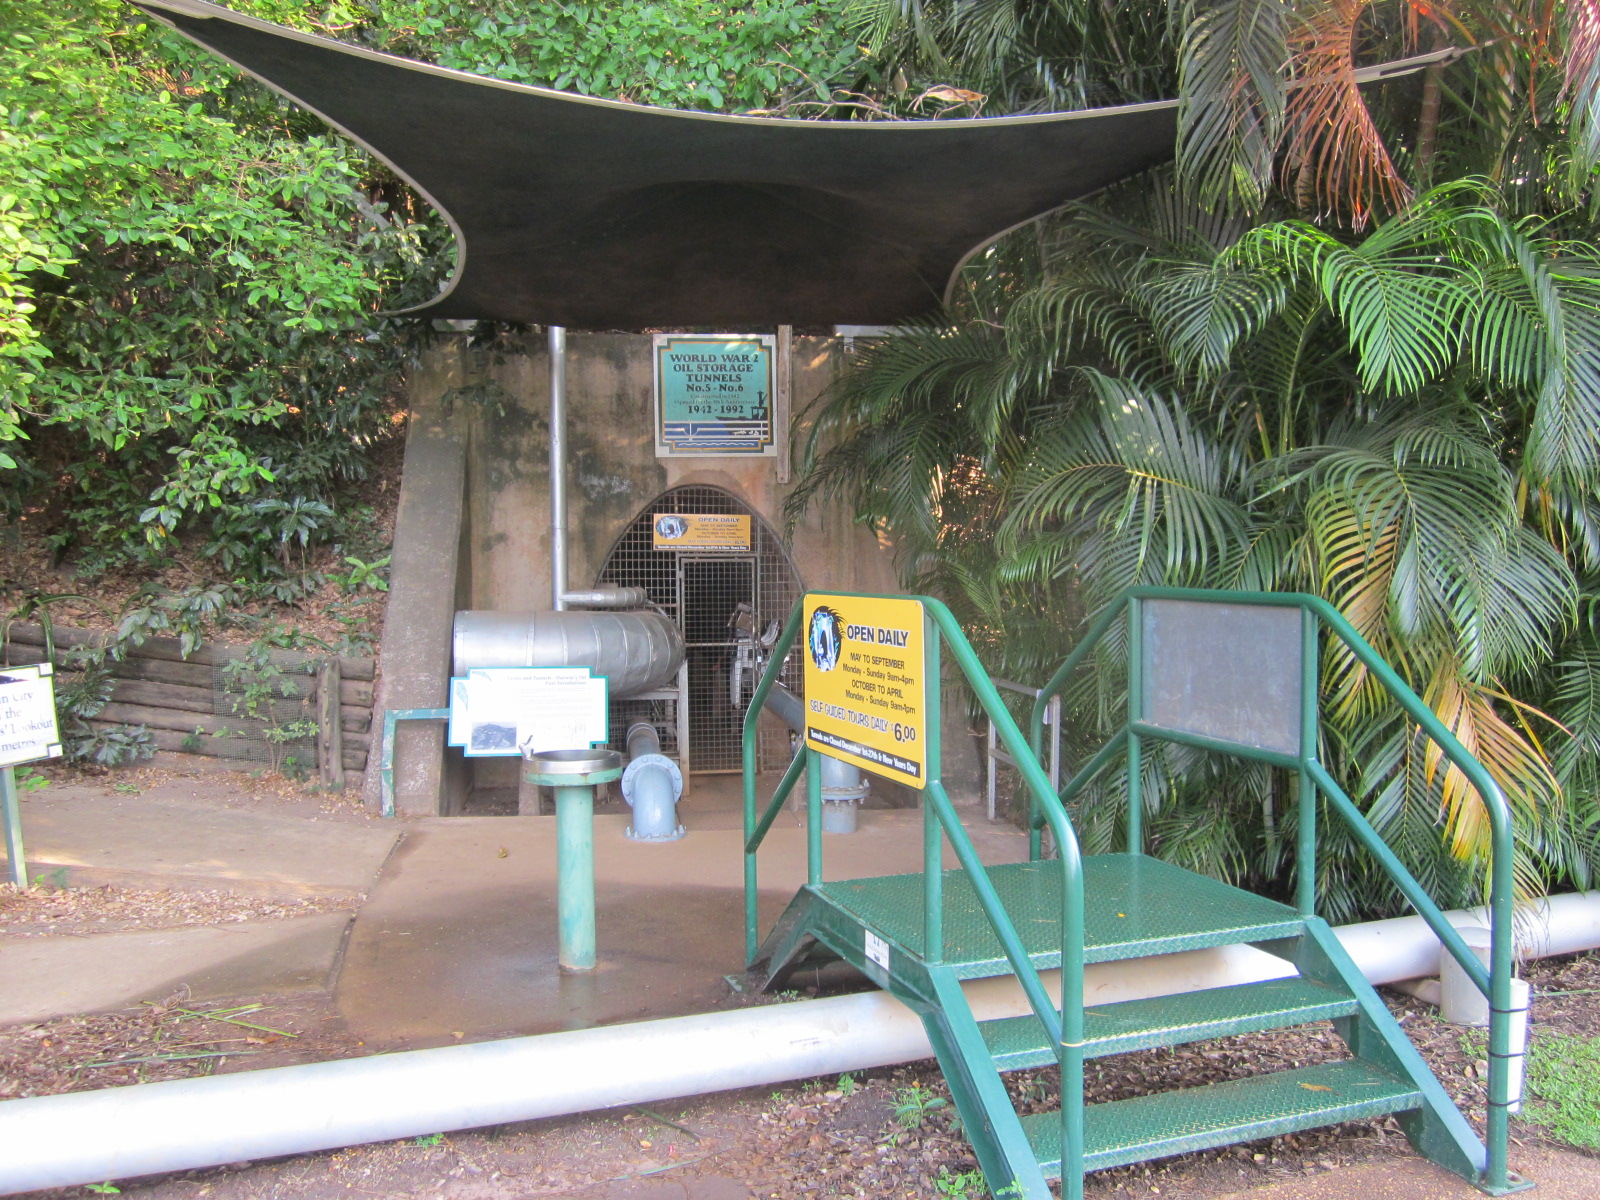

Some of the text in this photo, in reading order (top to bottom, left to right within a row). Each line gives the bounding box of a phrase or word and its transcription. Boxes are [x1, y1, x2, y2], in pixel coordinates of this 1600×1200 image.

[670, 354, 759, 363] WORLD WAR 2
[673, 363, 754, 372] OIL STORAGE
[686, 373, 742, 382] TUNNELS
[686, 384, 711, 392] No.5
[719, 384, 744, 392] No.6
[688, 405, 712, 414] 1942
[720, 405, 744, 414] 1992
[846, 623, 909, 647] OPEN DAILY
[850, 652, 905, 670] MAY TO SEPTEMBER
[843, 663, 862, 676] Monday
[866, 667, 886, 681] Sunday
[887, 672, 915, 686] 9am-4pm
[851, 679, 903, 699] OCTOBER TO APRIL
[845, 689, 865, 704] Monday
[869, 695, 889, 710] Sunday
[810, 699, 823, 713] SELF
[824, 703, 846, 721] GUIDED
[848, 710, 869, 728] TOURS
[871, 716, 889, 732] DAILY
[10, 719, 54, 734] Lokout
[841, 740, 862, 754] December
[882, 753, 894, 765] New
[893, 757, 906, 770] Years
[906, 761, 917, 775] Day
